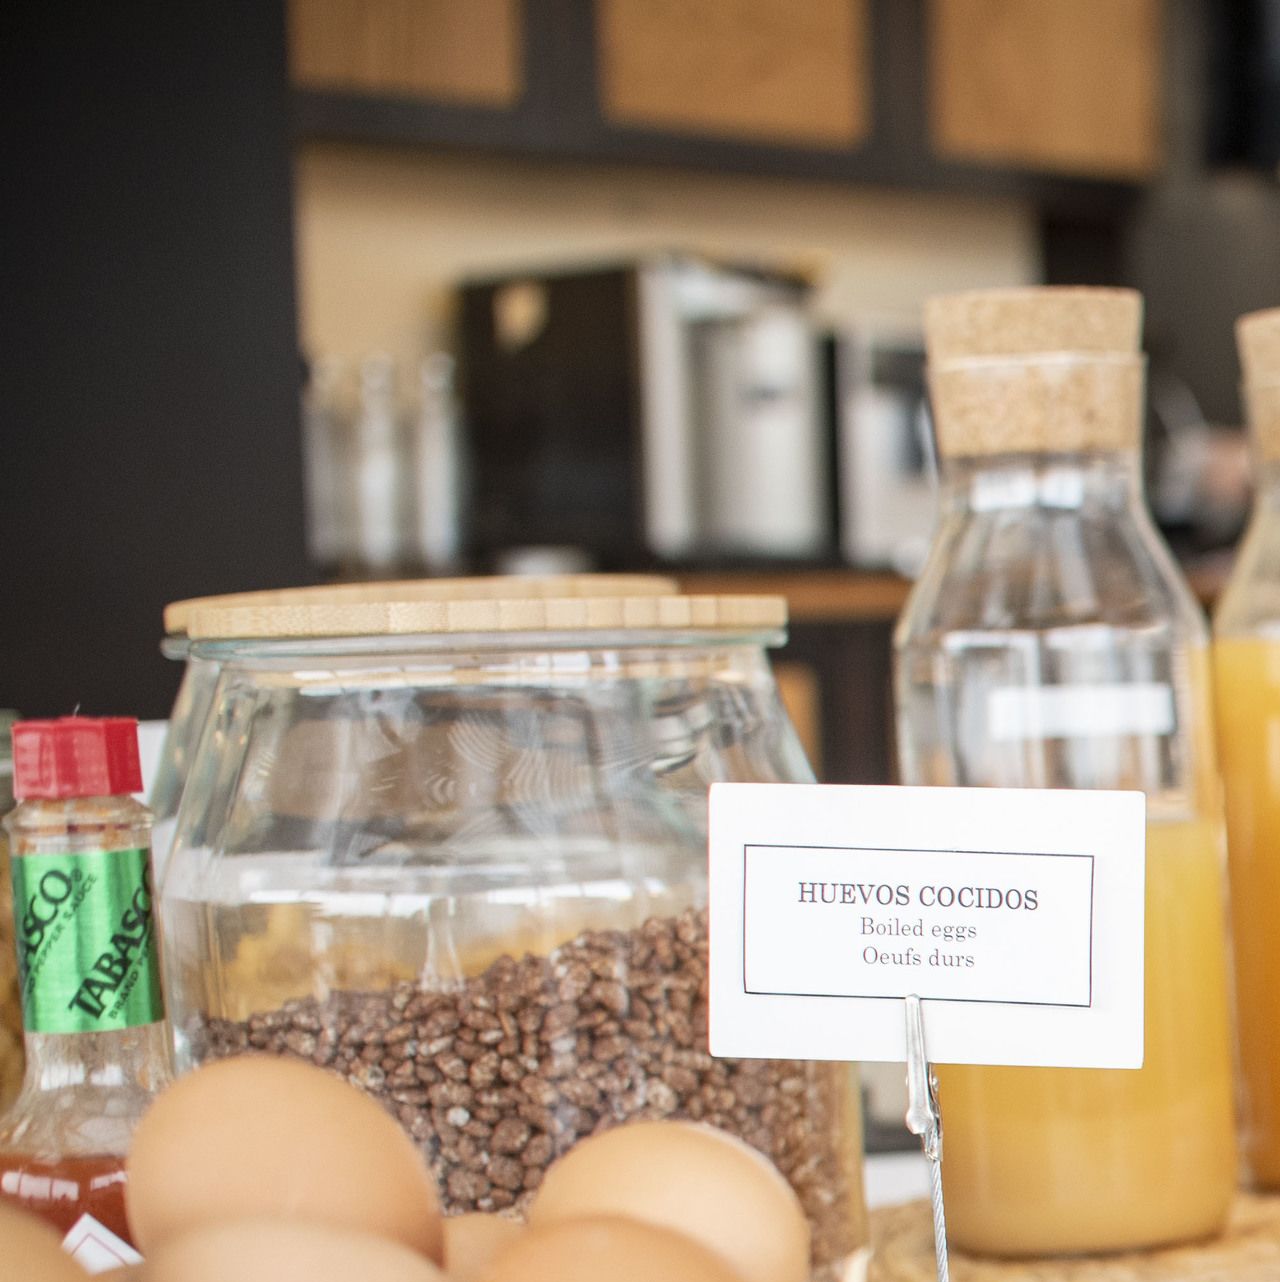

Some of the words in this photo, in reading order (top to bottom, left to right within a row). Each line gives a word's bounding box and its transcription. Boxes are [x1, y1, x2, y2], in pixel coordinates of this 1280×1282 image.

[798, 881, 911, 907] HUEVOS
[918, 885, 1039, 911] COCIDOS
[859, 916, 924, 938] Boiled
[931, 924, 977, 943] eggs
[862, 945, 922, 966] Oeufs
[928, 947, 975, 968] durs
[108, 970, 139, 1020] BRAND
